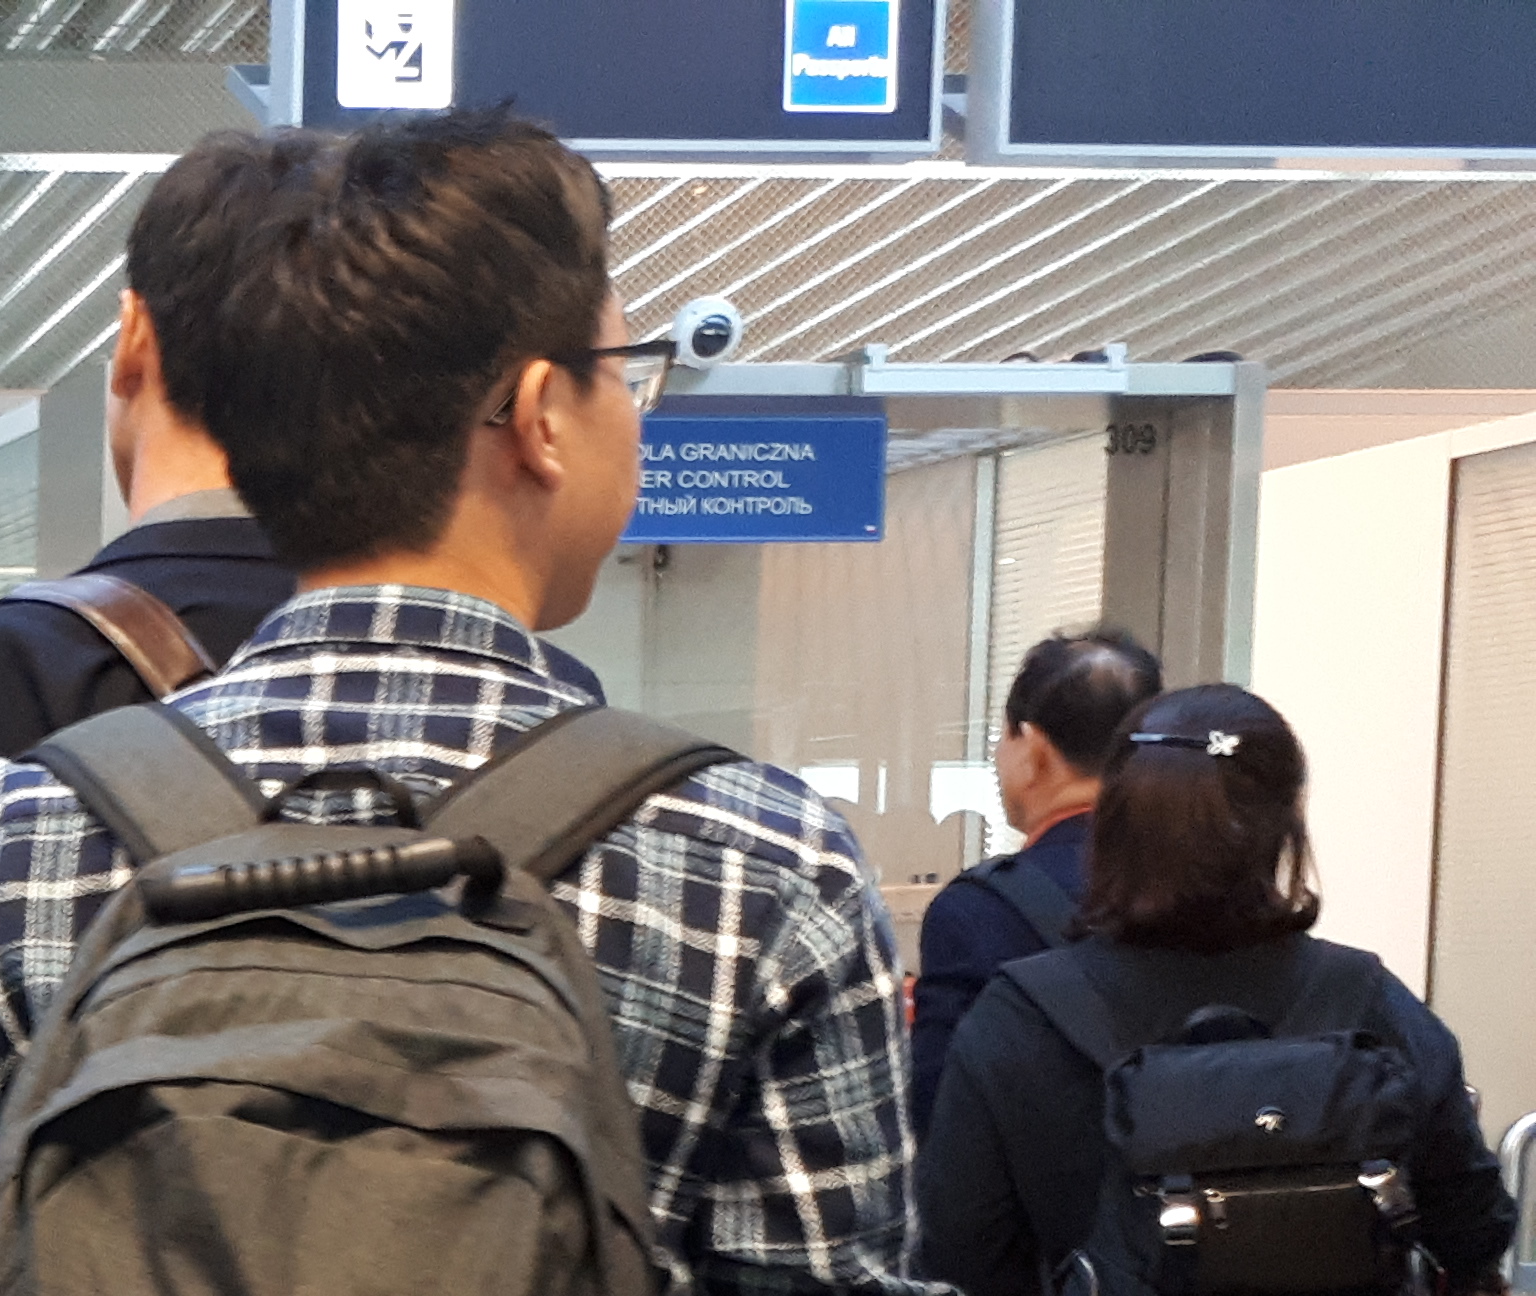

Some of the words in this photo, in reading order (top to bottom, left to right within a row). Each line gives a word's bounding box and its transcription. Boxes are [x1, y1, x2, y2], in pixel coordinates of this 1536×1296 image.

[1104, 423, 1157, 455] 309
[679, 443, 816, 462] GRANICZNA
[677, 470, 791, 488] CONTROL
[700, 497, 813, 515] КОНТРОЛЬ
